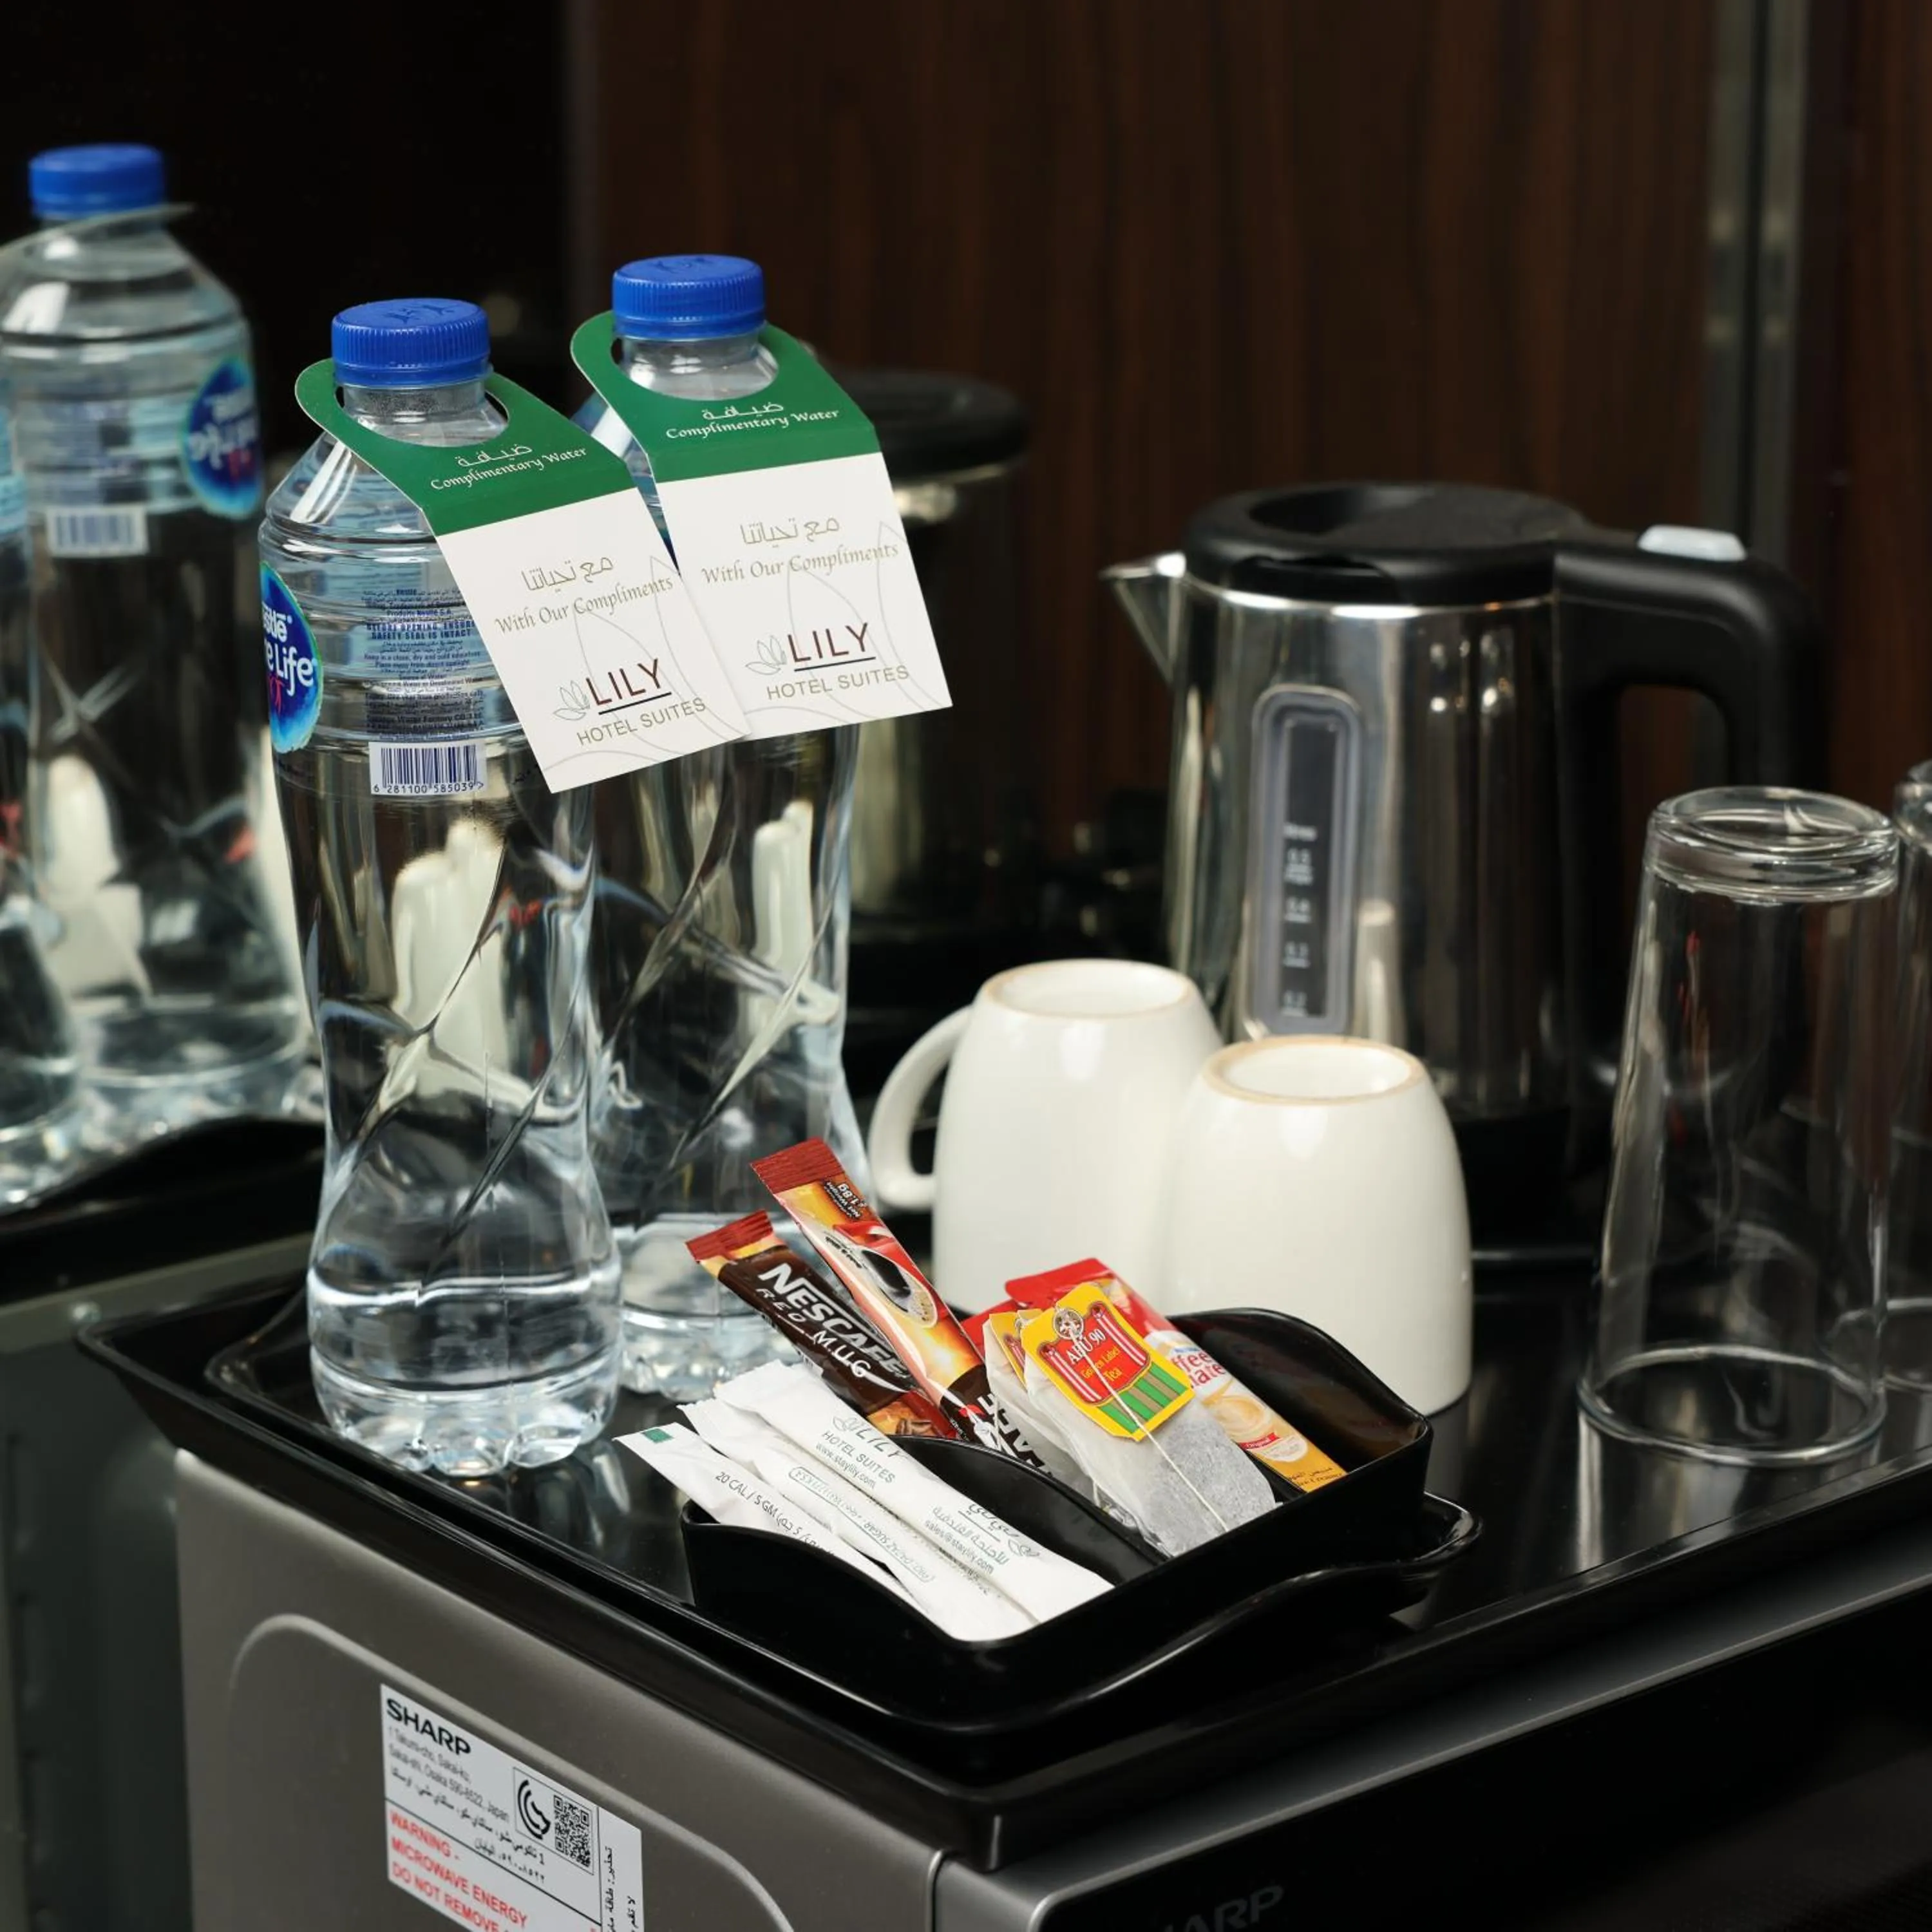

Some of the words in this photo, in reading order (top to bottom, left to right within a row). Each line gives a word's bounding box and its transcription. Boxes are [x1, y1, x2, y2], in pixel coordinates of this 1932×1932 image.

[666, 416, 789, 439] Complimentary
[790, 410, 839, 422] Water
[431, 458, 544, 489] Complimentary
[542, 448, 587, 463] Water
[740, 518, 799, 548] تحياتنا
[804, 518, 839, 542] مع
[521, 560, 576, 593] تحياتنا
[580, 557, 613, 583] مع
[701, 559, 744, 583] With
[750, 561, 784, 578] Our
[790, 544, 898, 576] Compliments
[495, 607, 536, 634] With
[539, 605, 569, 623] Our
[573, 578, 674, 615] Compliments
[788, 622, 868, 662] LILY
[276, 644, 314, 696] Life
[585, 658, 661, 706] LILY
[767, 678, 833, 700] HOTEL
[838, 665, 909, 690] SUITES
[577, 719, 638, 746] HOTEL
[640, 697, 706, 728] SUITES
[434, 782, 473, 793] 585039
[756, 1288, 806, 1323] RED
[1088, 1328, 1106, 1345] 90
[1103, 1367, 1122, 1381] Tea
[1171, 1352, 1212, 1372] ffee
[822, 1430, 855, 1457] HOTEL
[857, 1454, 895, 1484] SUITES
[715, 1471, 730, 1483] 20
[729, 1479, 748, 1497] CAL
[754, 1495, 762, 1505] 5
[762, 1501, 778, 1517] GM
[387, 1698, 471, 1756] SHARP
[390, 1810, 451, 1858] WARNING
[392, 1836, 469, 1894] MICROWAVE
[473, 1885, 528, 1927] ENERGY
[392, 1861, 411, 1884] DO
[415, 1876, 440, 1900] NOT
[444, 1893, 499, 1932] REMOVE
[1163, 1884, 1285, 1932] ARP
